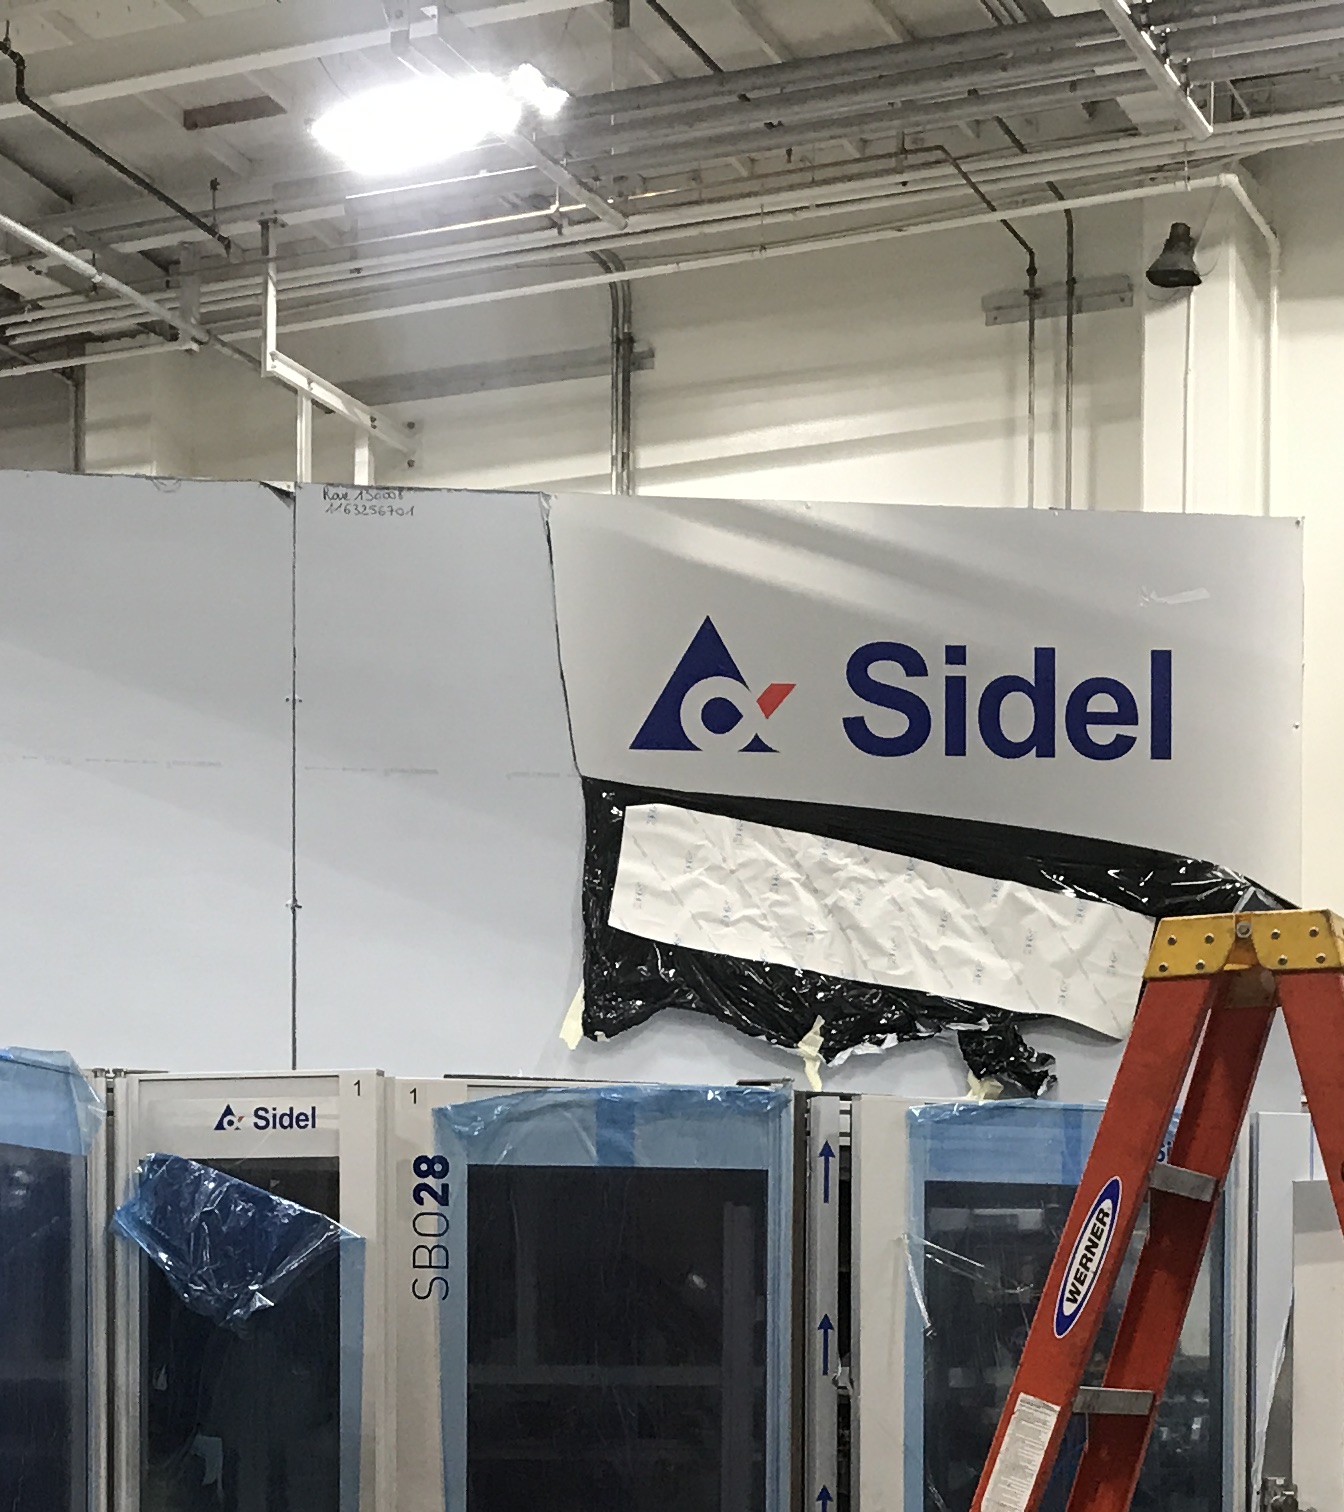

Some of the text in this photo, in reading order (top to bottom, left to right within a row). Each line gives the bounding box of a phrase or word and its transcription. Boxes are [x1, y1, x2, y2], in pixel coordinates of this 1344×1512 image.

[842, 641, 1173, 760] Sidel
[353, 1080, 361, 1096] 1
[410, 1088, 418, 1104] 1
[252, 1106, 317, 1130] Sidel
[1065, 1206, 1111, 1304] WERNER
